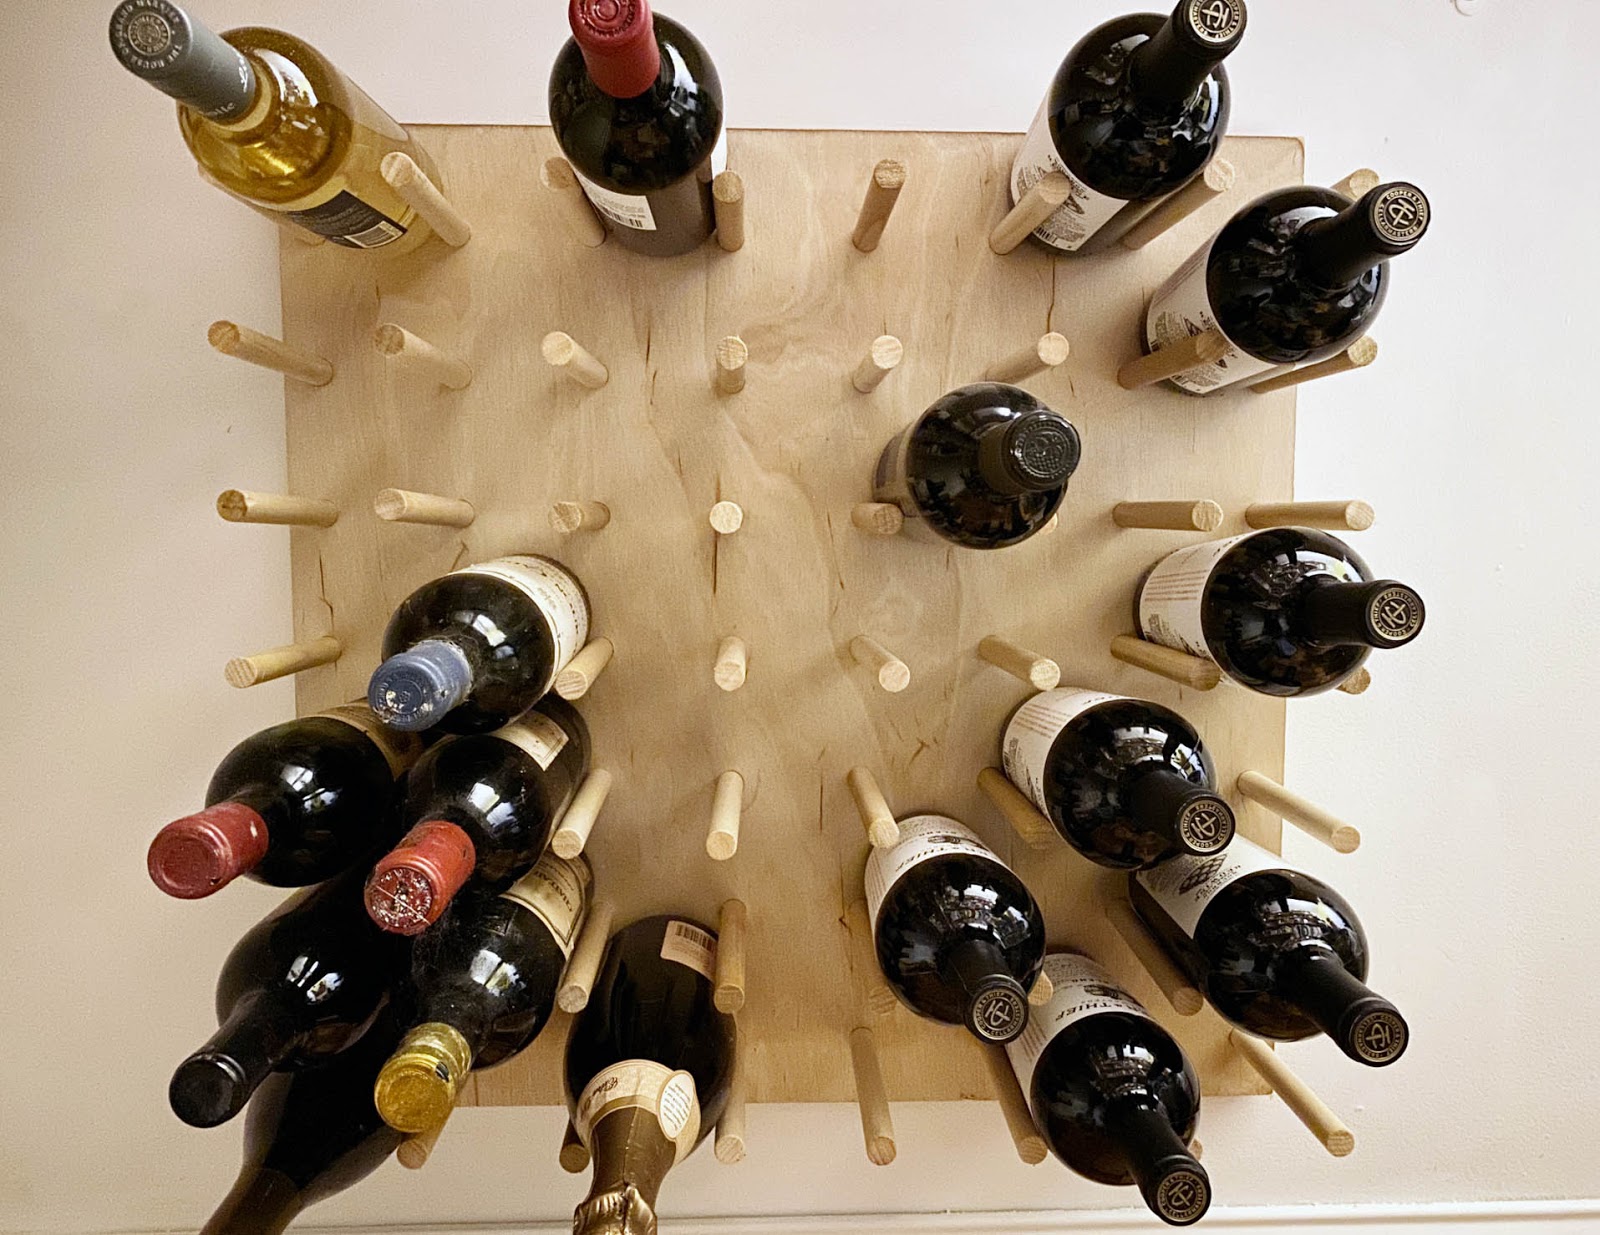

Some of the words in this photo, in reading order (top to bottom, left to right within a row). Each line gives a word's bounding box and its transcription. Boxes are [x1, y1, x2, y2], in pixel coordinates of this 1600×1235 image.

[167, 43, 182, 61] THE
[128, 55, 165, 69] HOUSE
[1386, 191, 1413, 200] COOPER
[1416, 201, 1424, 220] THIEF
[1373, 602, 1381, 622] THIEF
[1380, 626, 1407, 637] COOPER
[1183, 812, 1192, 831] THIEF
[1188, 835, 1214, 848] COOPER
[1055, 1002, 1112, 1023] THIEF
